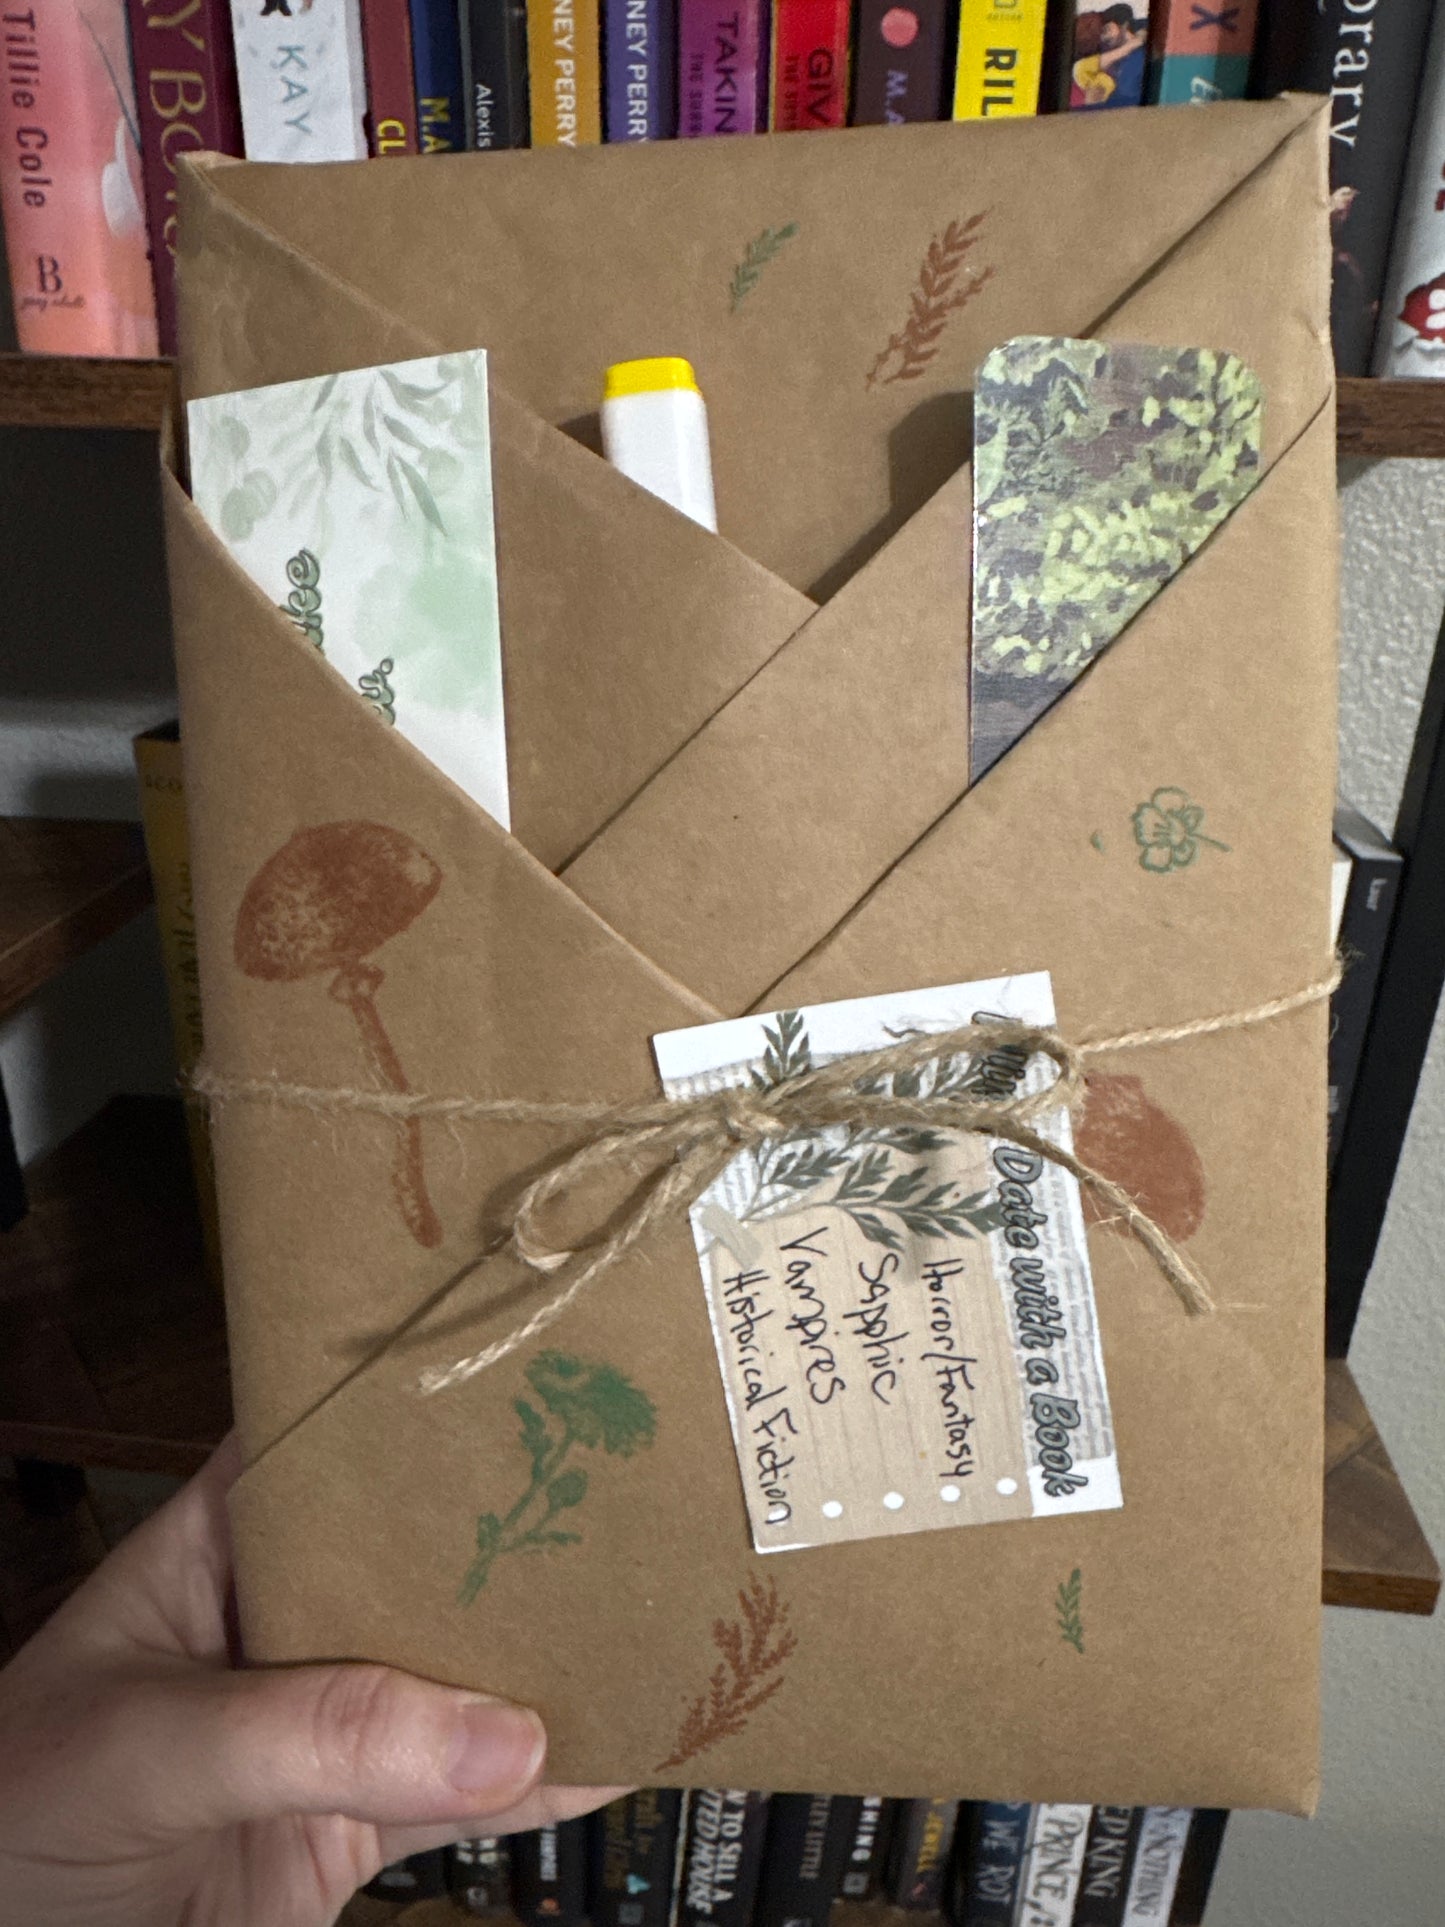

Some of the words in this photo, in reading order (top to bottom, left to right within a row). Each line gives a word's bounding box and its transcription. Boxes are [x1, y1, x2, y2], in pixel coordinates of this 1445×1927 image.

[3, 11, 40, 109] Tillie
[278, 45, 312, 135] KAY
[554, 59, 577, 148] PERRY
[981, 48, 1018, 116] RIL
[475, 83, 495, 148] Alexis
[16, 126, 51, 208] Cole
[993, 1145, 1043, 1251] Date
[723, 1268, 787, 1412] Historical
[779, 1226, 847, 1405] Vampires
[843, 1253, 909, 1406] Sapphic
[1008, 1256, 1067, 1357] with
[923, 1257, 978, 1478] Horror/Fantasy
[1025, 1361, 1059, 1386] a
[752, 1406, 798, 1526] Fiction
[1031, 1393, 1089, 1499] Book
[713, 1842, 742, 1883] SELL
[721, 1810, 746, 1838] TO
[1032, 1811, 1084, 1900] PRINCE
[1084, 1837, 1128, 1898] KING
[712, 1888, 733, 1902] A
